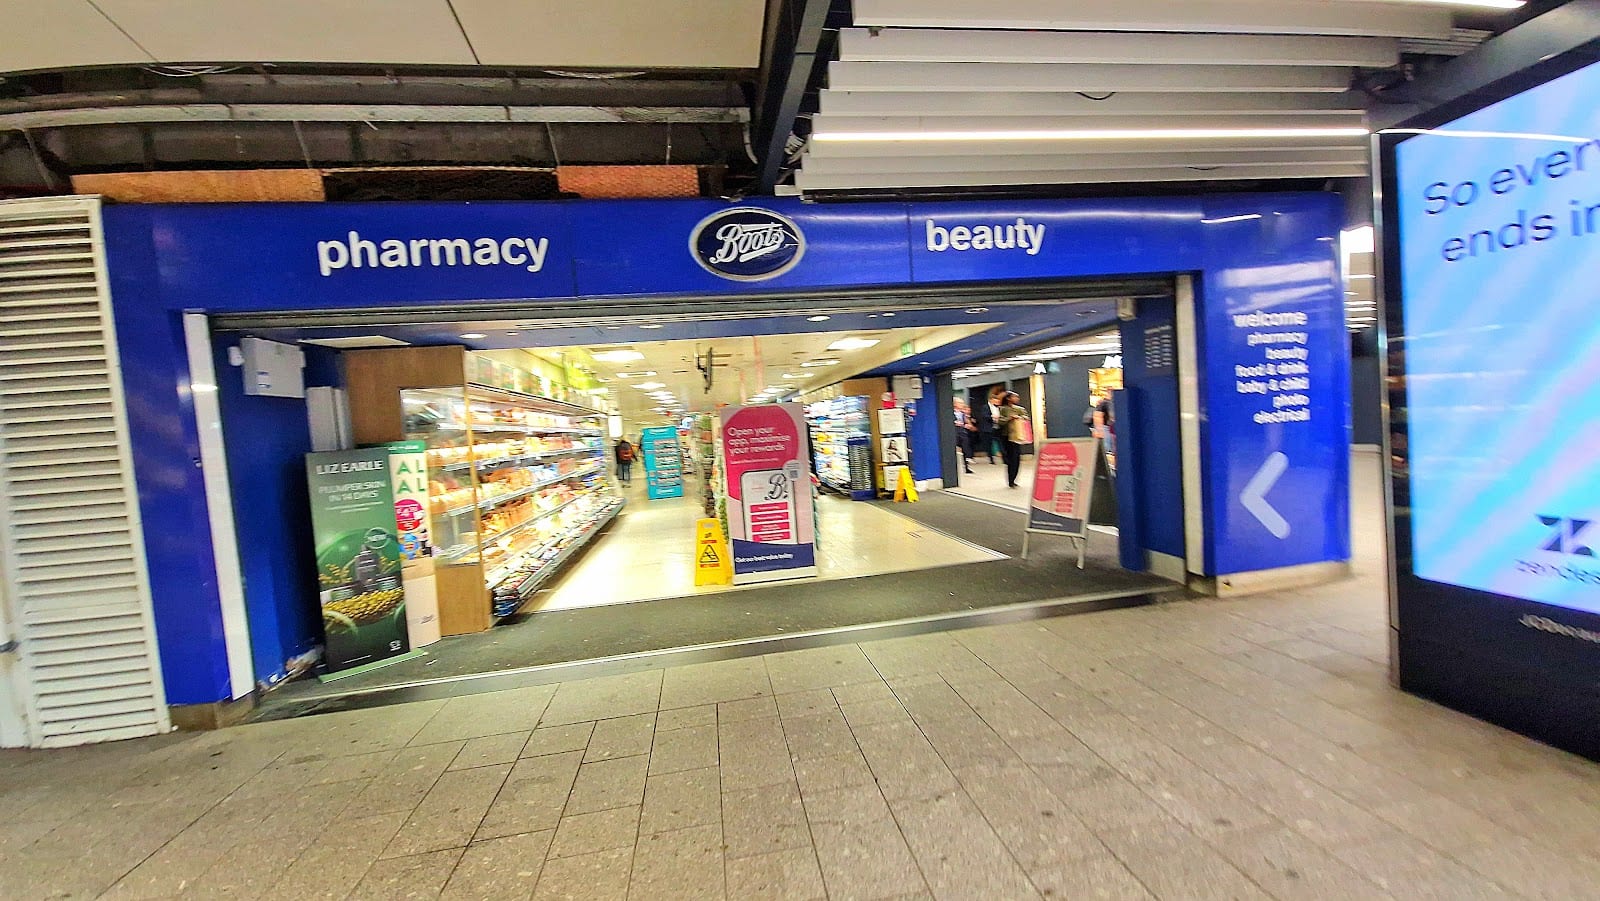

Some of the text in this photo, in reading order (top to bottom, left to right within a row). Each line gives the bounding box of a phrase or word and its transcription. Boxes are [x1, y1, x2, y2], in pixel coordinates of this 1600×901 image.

[1424, 139, 1600, 214] So ever
[708, 222, 790, 264] Boots
[926, 217, 1046, 255] beauty
[1441, 209, 1558, 262] ends
[317, 230, 549, 276] pharmacy
[1233, 310, 1308, 328] welcome
[1247, 331, 1309, 347] pharmacy
[1265, 346, 1309, 360] beauty
[1235, 364, 1266, 377] food
[1277, 361, 1309, 375] drink
[1236, 380, 1267, 394] baby
[1272, 393, 1310, 408] photo
[1253, 407, 1311, 424] electrical
[728, 427, 776, 438] Open your
[749, 433, 792, 444] maximise
[728, 441, 786, 457] your rewards
[316, 460, 384, 475] LIZ EARLE
